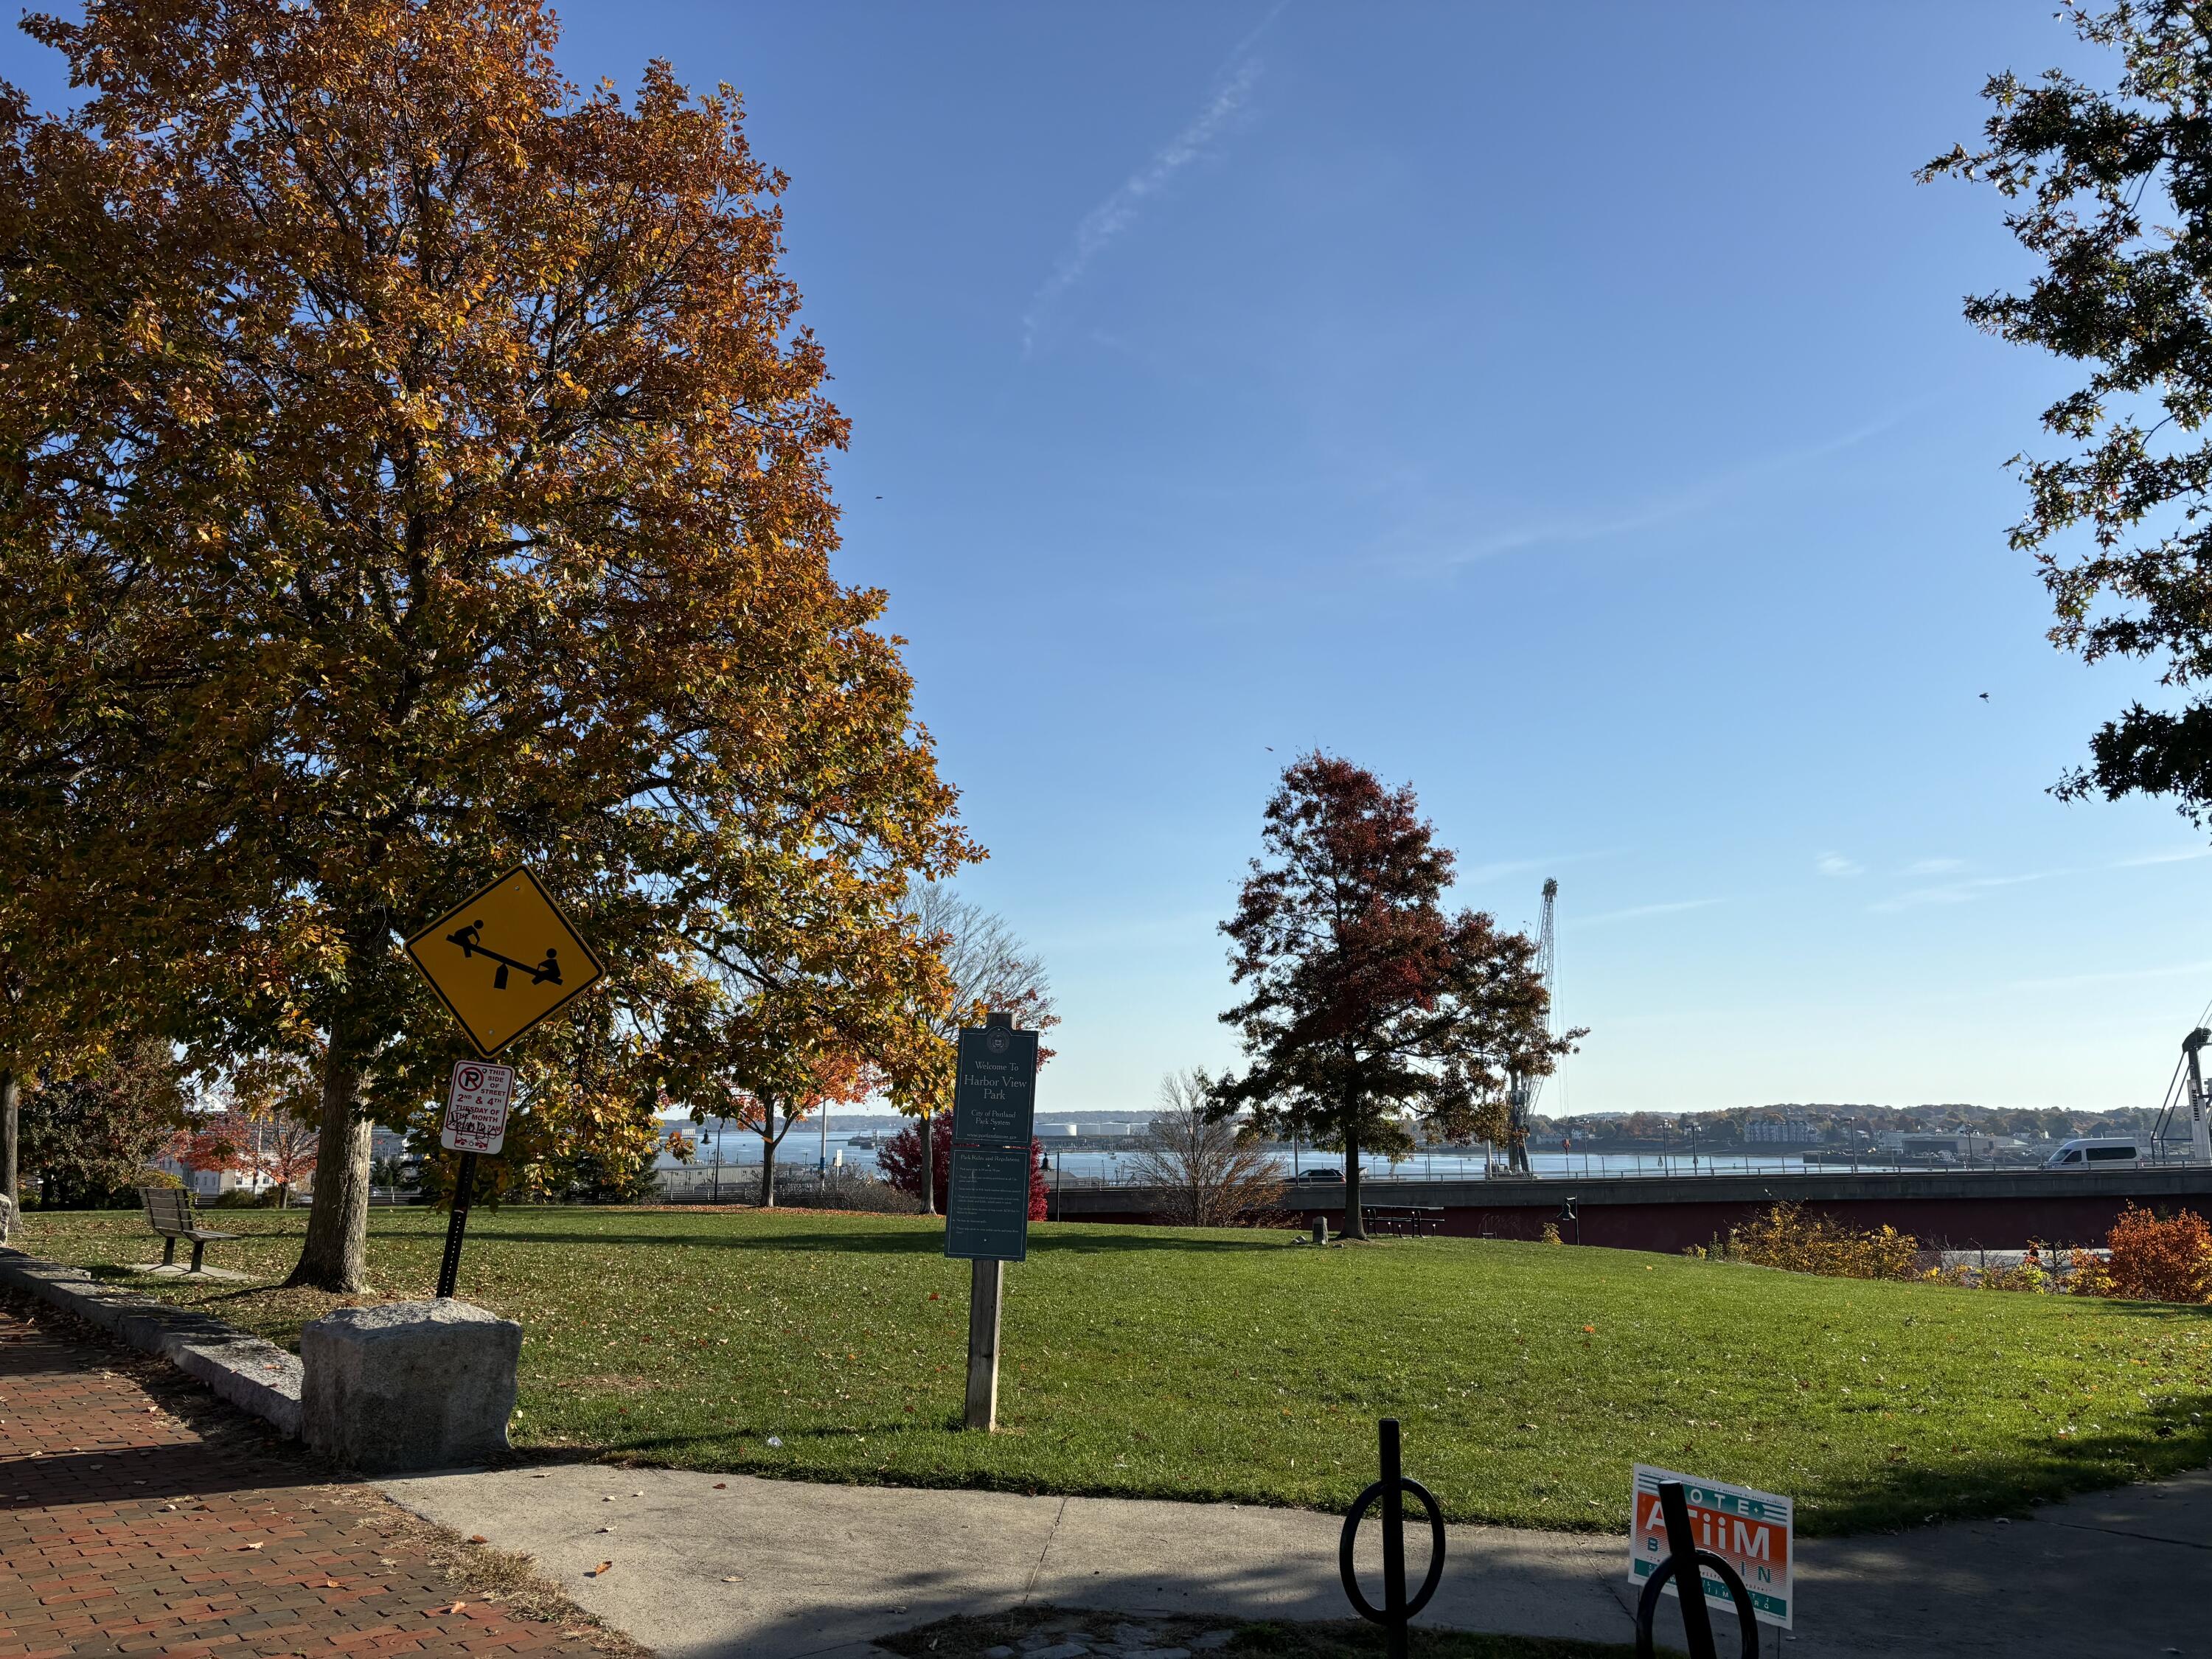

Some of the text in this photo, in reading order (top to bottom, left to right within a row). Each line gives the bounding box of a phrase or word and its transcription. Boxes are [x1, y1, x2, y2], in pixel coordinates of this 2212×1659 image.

[975, 1061, 1019, 1071] Welcome To
[964, 1074, 1027, 1088] Harbor View
[481, 1088, 507, 1096] STREET
[984, 1089, 1006, 1100] Park
[458, 1093, 472, 1102] 2ND
[487, 1097, 501, 1106] 4TH
[455, 1105, 488, 1114] TUESDAY
[971, 1109, 984, 1117] City
[992, 1110, 1016, 1118] Portland
[471, 1114, 498, 1123] MONTH
[990, 1118, 1010, 1126] System
[1690, 1489, 1749, 1516] OTE
